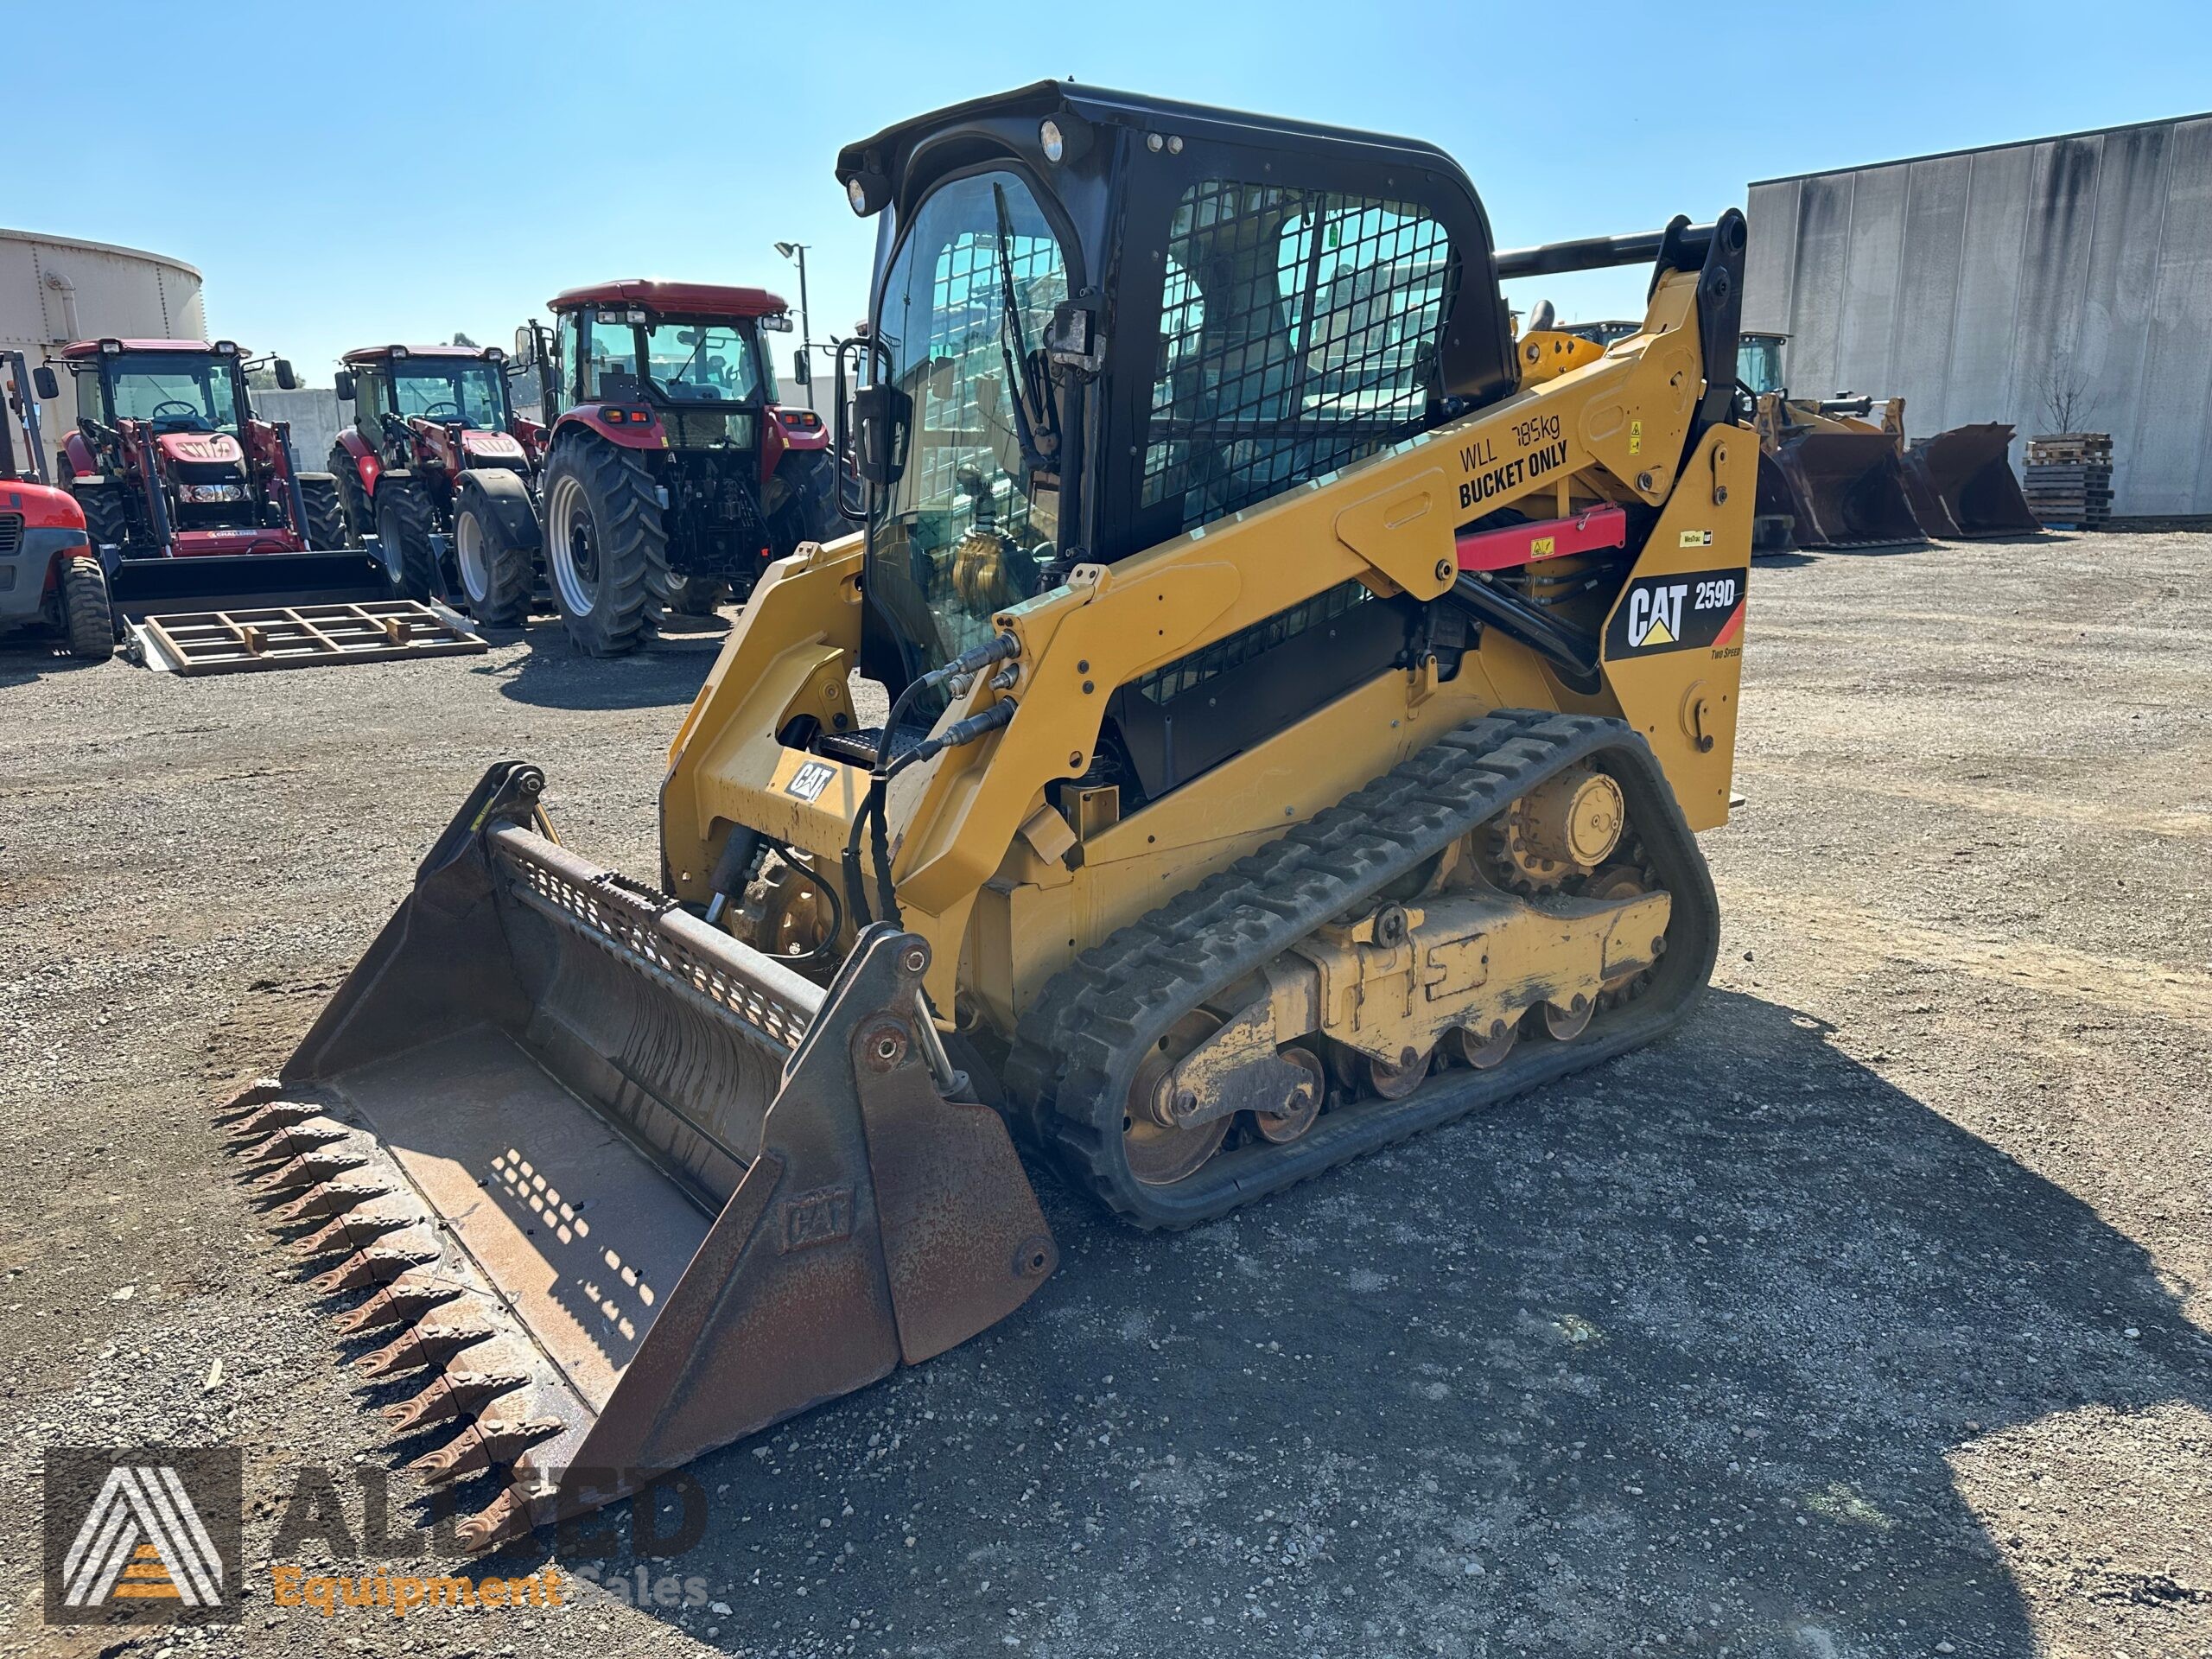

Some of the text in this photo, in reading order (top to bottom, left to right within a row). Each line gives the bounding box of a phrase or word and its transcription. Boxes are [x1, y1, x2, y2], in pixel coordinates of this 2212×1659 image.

[1459, 438, 1498, 473] WLL
[1459, 439, 1567, 510] BUCKET ONLY
[1628, 579, 1735, 647] CAT 259D
[790, 763, 833, 802] CAT
